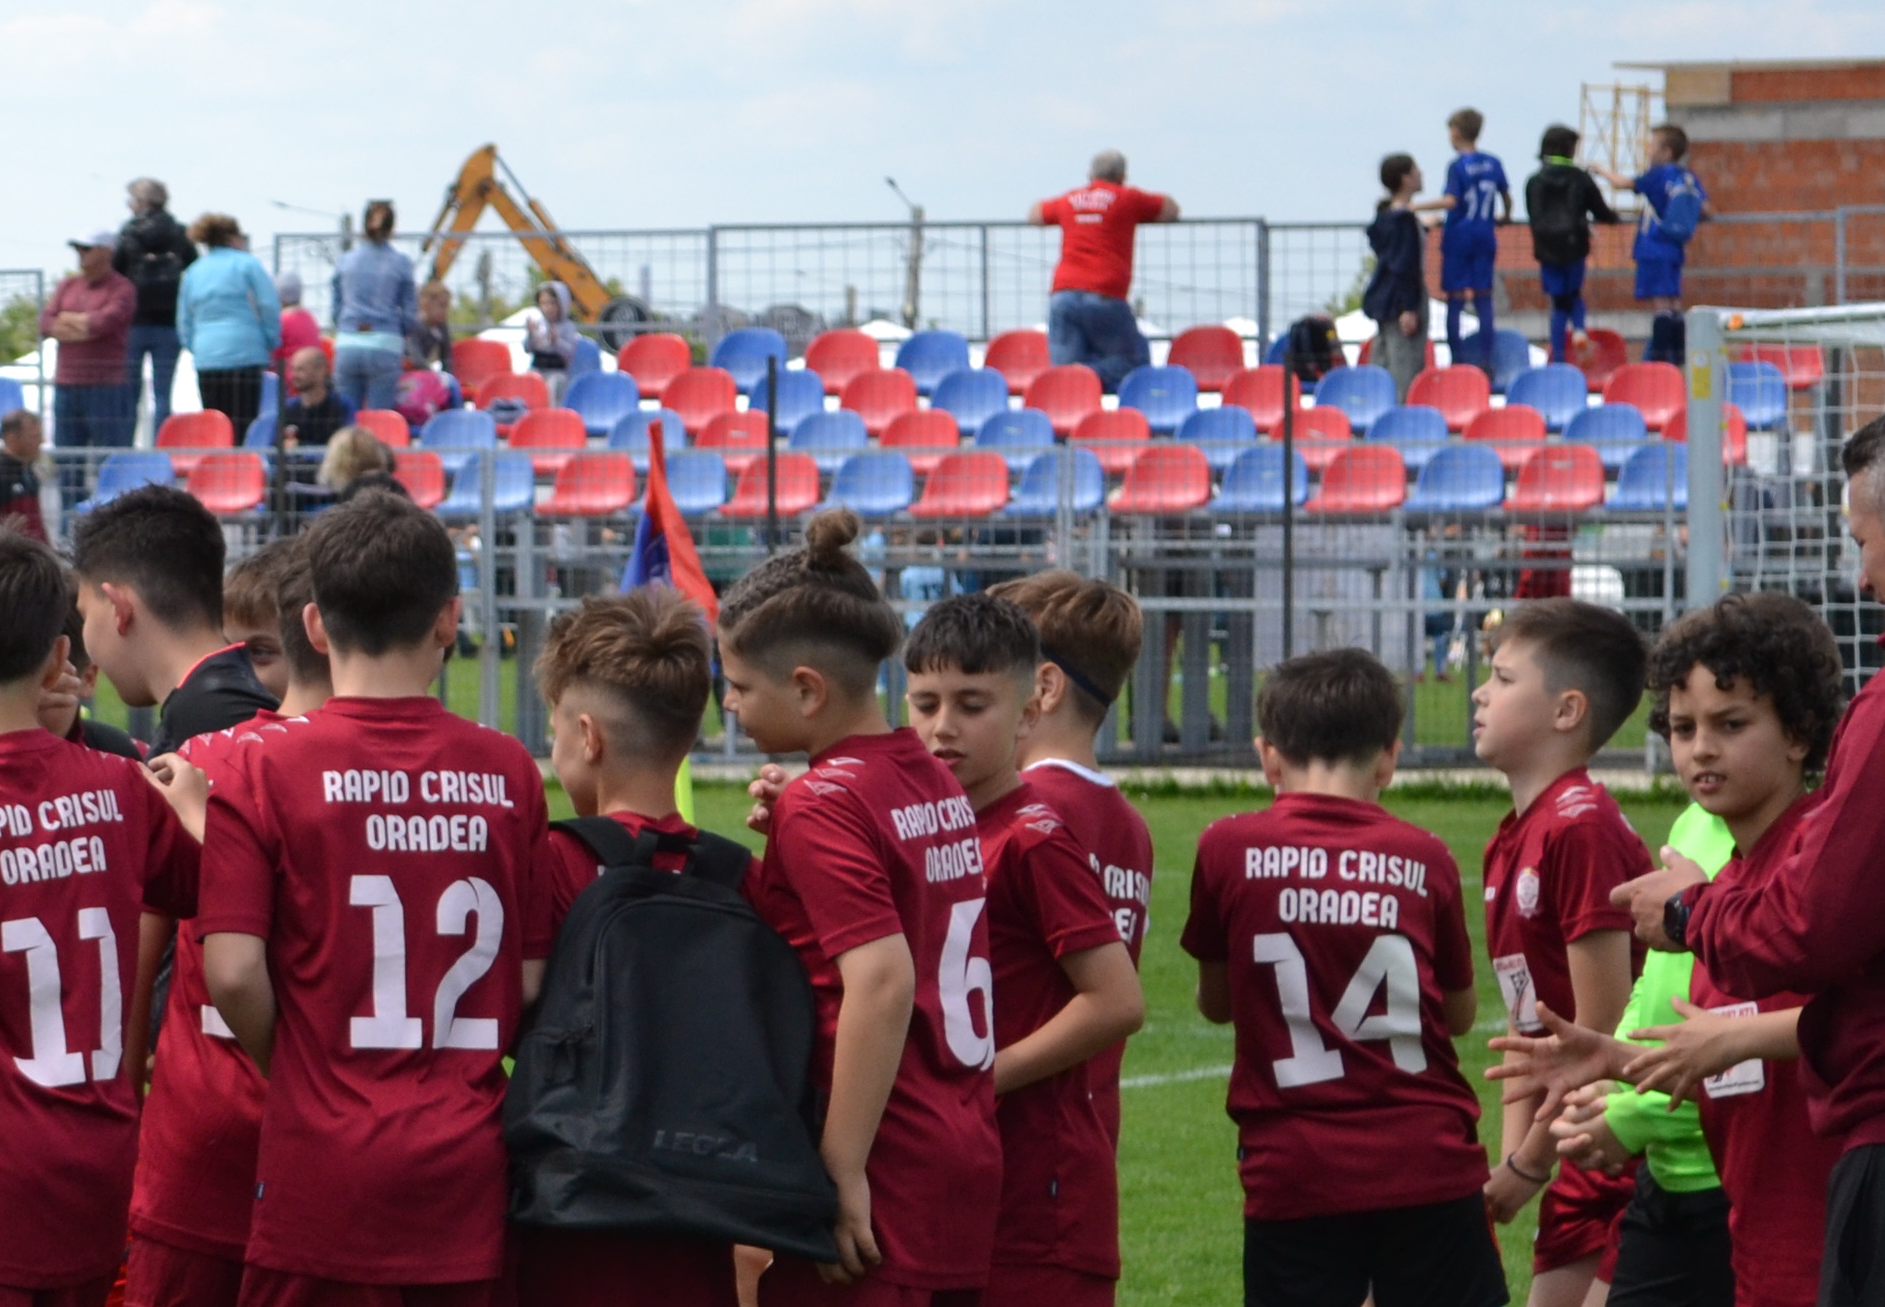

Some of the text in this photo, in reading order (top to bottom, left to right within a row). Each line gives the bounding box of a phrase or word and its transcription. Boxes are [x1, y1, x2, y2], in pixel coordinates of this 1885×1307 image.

[38, 789, 124, 832] CRISUL
[323, 770, 514, 808] RAPID CRISUL
[936, 795, 976, 831] CRIS
[0, 834, 107, 886] ORADEA
[366, 815, 487, 853] ORADEA
[1245, 846, 1428, 898] RAPID CRISUL
[1278, 888, 1399, 929] ORADEA
[349, 874, 504, 1051] 12
[938, 897, 995, 1073] 6
[1, 906, 123, 1088] 11
[1253, 932, 1428, 1088] 14
